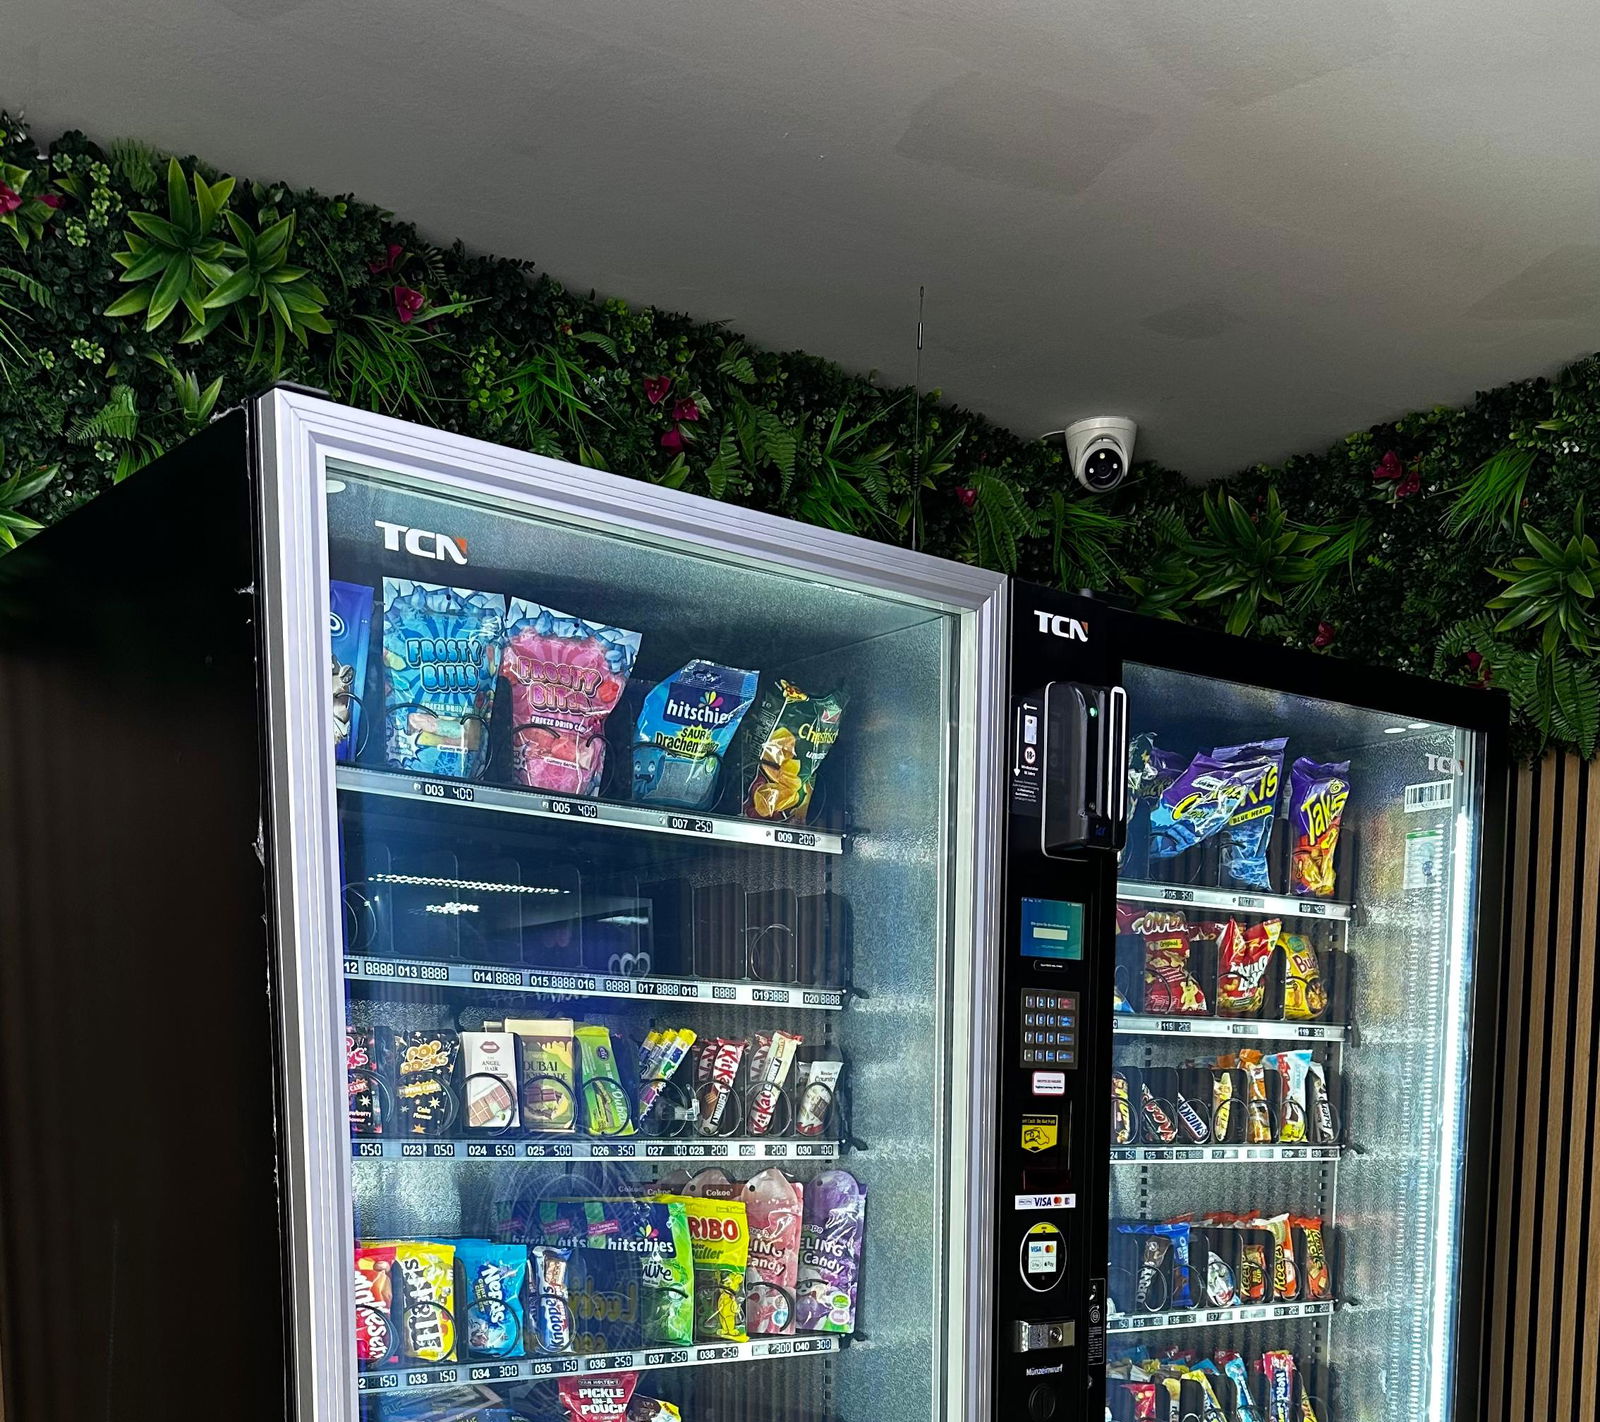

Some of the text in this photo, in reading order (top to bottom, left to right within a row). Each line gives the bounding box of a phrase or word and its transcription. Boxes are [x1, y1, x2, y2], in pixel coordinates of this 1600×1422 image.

[375, 521, 467, 565] TCN
[1034, 610, 1088, 642] TCN
[406, 640, 483, 669] FROSTY
[421, 664, 480, 692] BITES
[517, 656, 602, 698] FROSTY
[1425, 753, 1464, 776] TCN
[424, 784, 473, 801] 003 400
[552, 802, 597, 818] 005 400
[672, 818, 712, 833] 007 250
[778, 833, 815, 846] 009 200
[344, 962, 358, 973] 12
[398, 966, 417, 978] 013
[474, 971, 492, 983] 014
[531, 975, 549, 987] 015
[578, 978, 595, 989] 016
[638, 983, 654, 994] 017
[682, 985, 697, 996] 018
[754, 990, 769, 1001] 019
[805, 993, 819, 1004] 020
[404, 1144, 421, 1156] 023
[469, 1145, 486, 1156] 024
[527, 1145, 545, 1156] 025
[593, 1145, 609, 1156] 026
[648, 1145, 663, 1156] 027
[689, 1145, 704, 1155] 028
[798, 1145, 812, 1155] 030
[1033, 1197, 1051, 1206] VISA
[688, 1216, 739, 1241] RIBO
[608, 1237, 674, 1254] hitschies
[804, 1251, 845, 1275] Candy
[795, 1341, 809, 1351] 040
[649, 1351, 687, 1364] 037 250
[700, 1348, 738, 1360] 038 250
[590, 1355, 633, 1369] 036 250
[472, 1367, 490, 1379] 034
[535, 1363, 552, 1375] 035
[380, 1375, 397, 1387] 150
[409, 1374, 428, 1386] 033
[579, 1388, 625, 1399] PICKLE
[581, 1404, 628, 1415] POUCH
